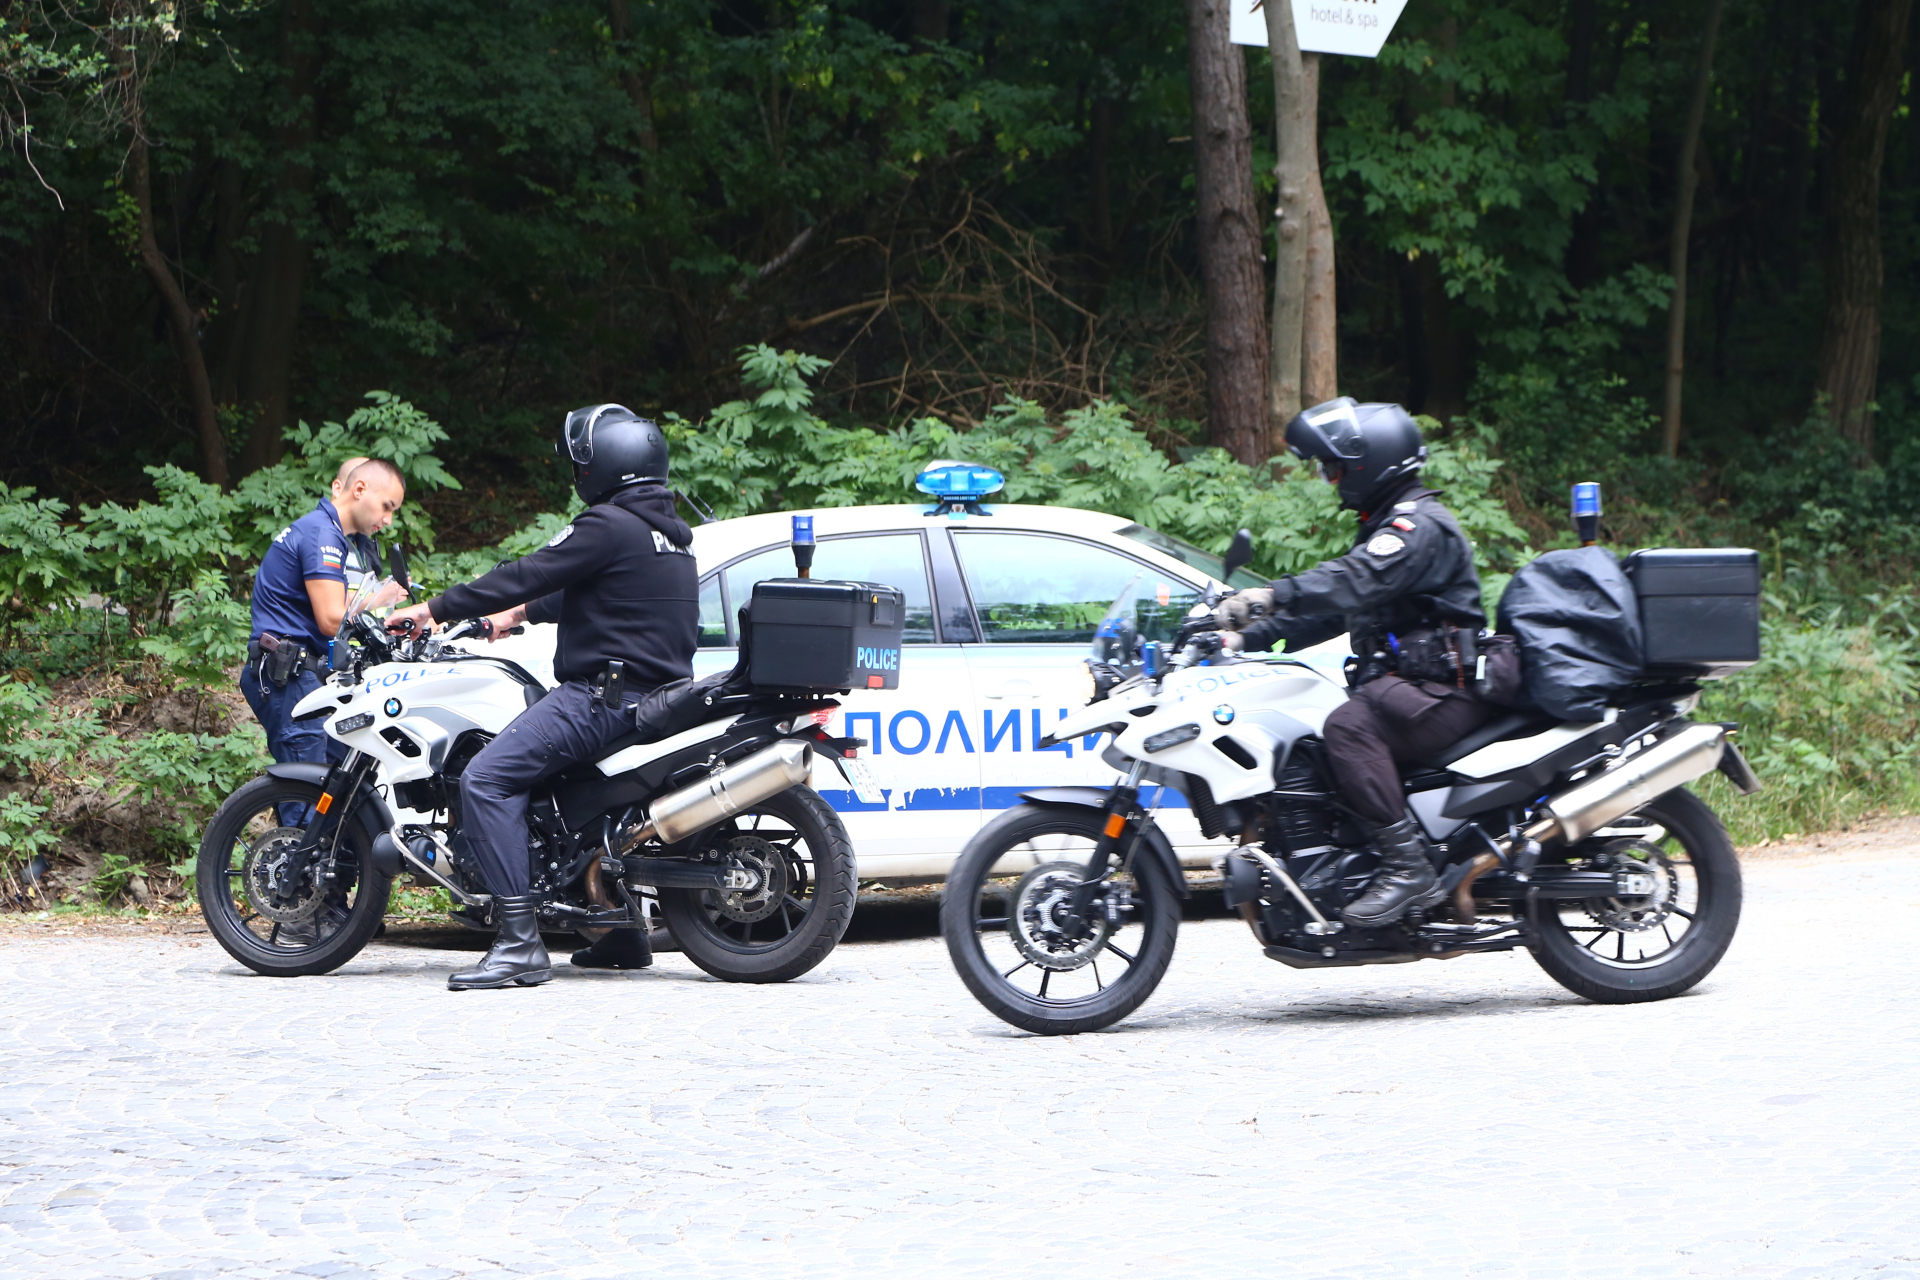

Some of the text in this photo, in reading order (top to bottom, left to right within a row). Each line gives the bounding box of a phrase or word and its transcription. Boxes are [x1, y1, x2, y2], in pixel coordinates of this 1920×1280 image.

[1311, 5, 1379, 30] hotel & spa
[320, 545, 343, 558] POLICE
[857, 646, 898, 670] POLICE
[365, 668, 465, 694] POLICE
[1176, 669, 1293, 701] POLICE
